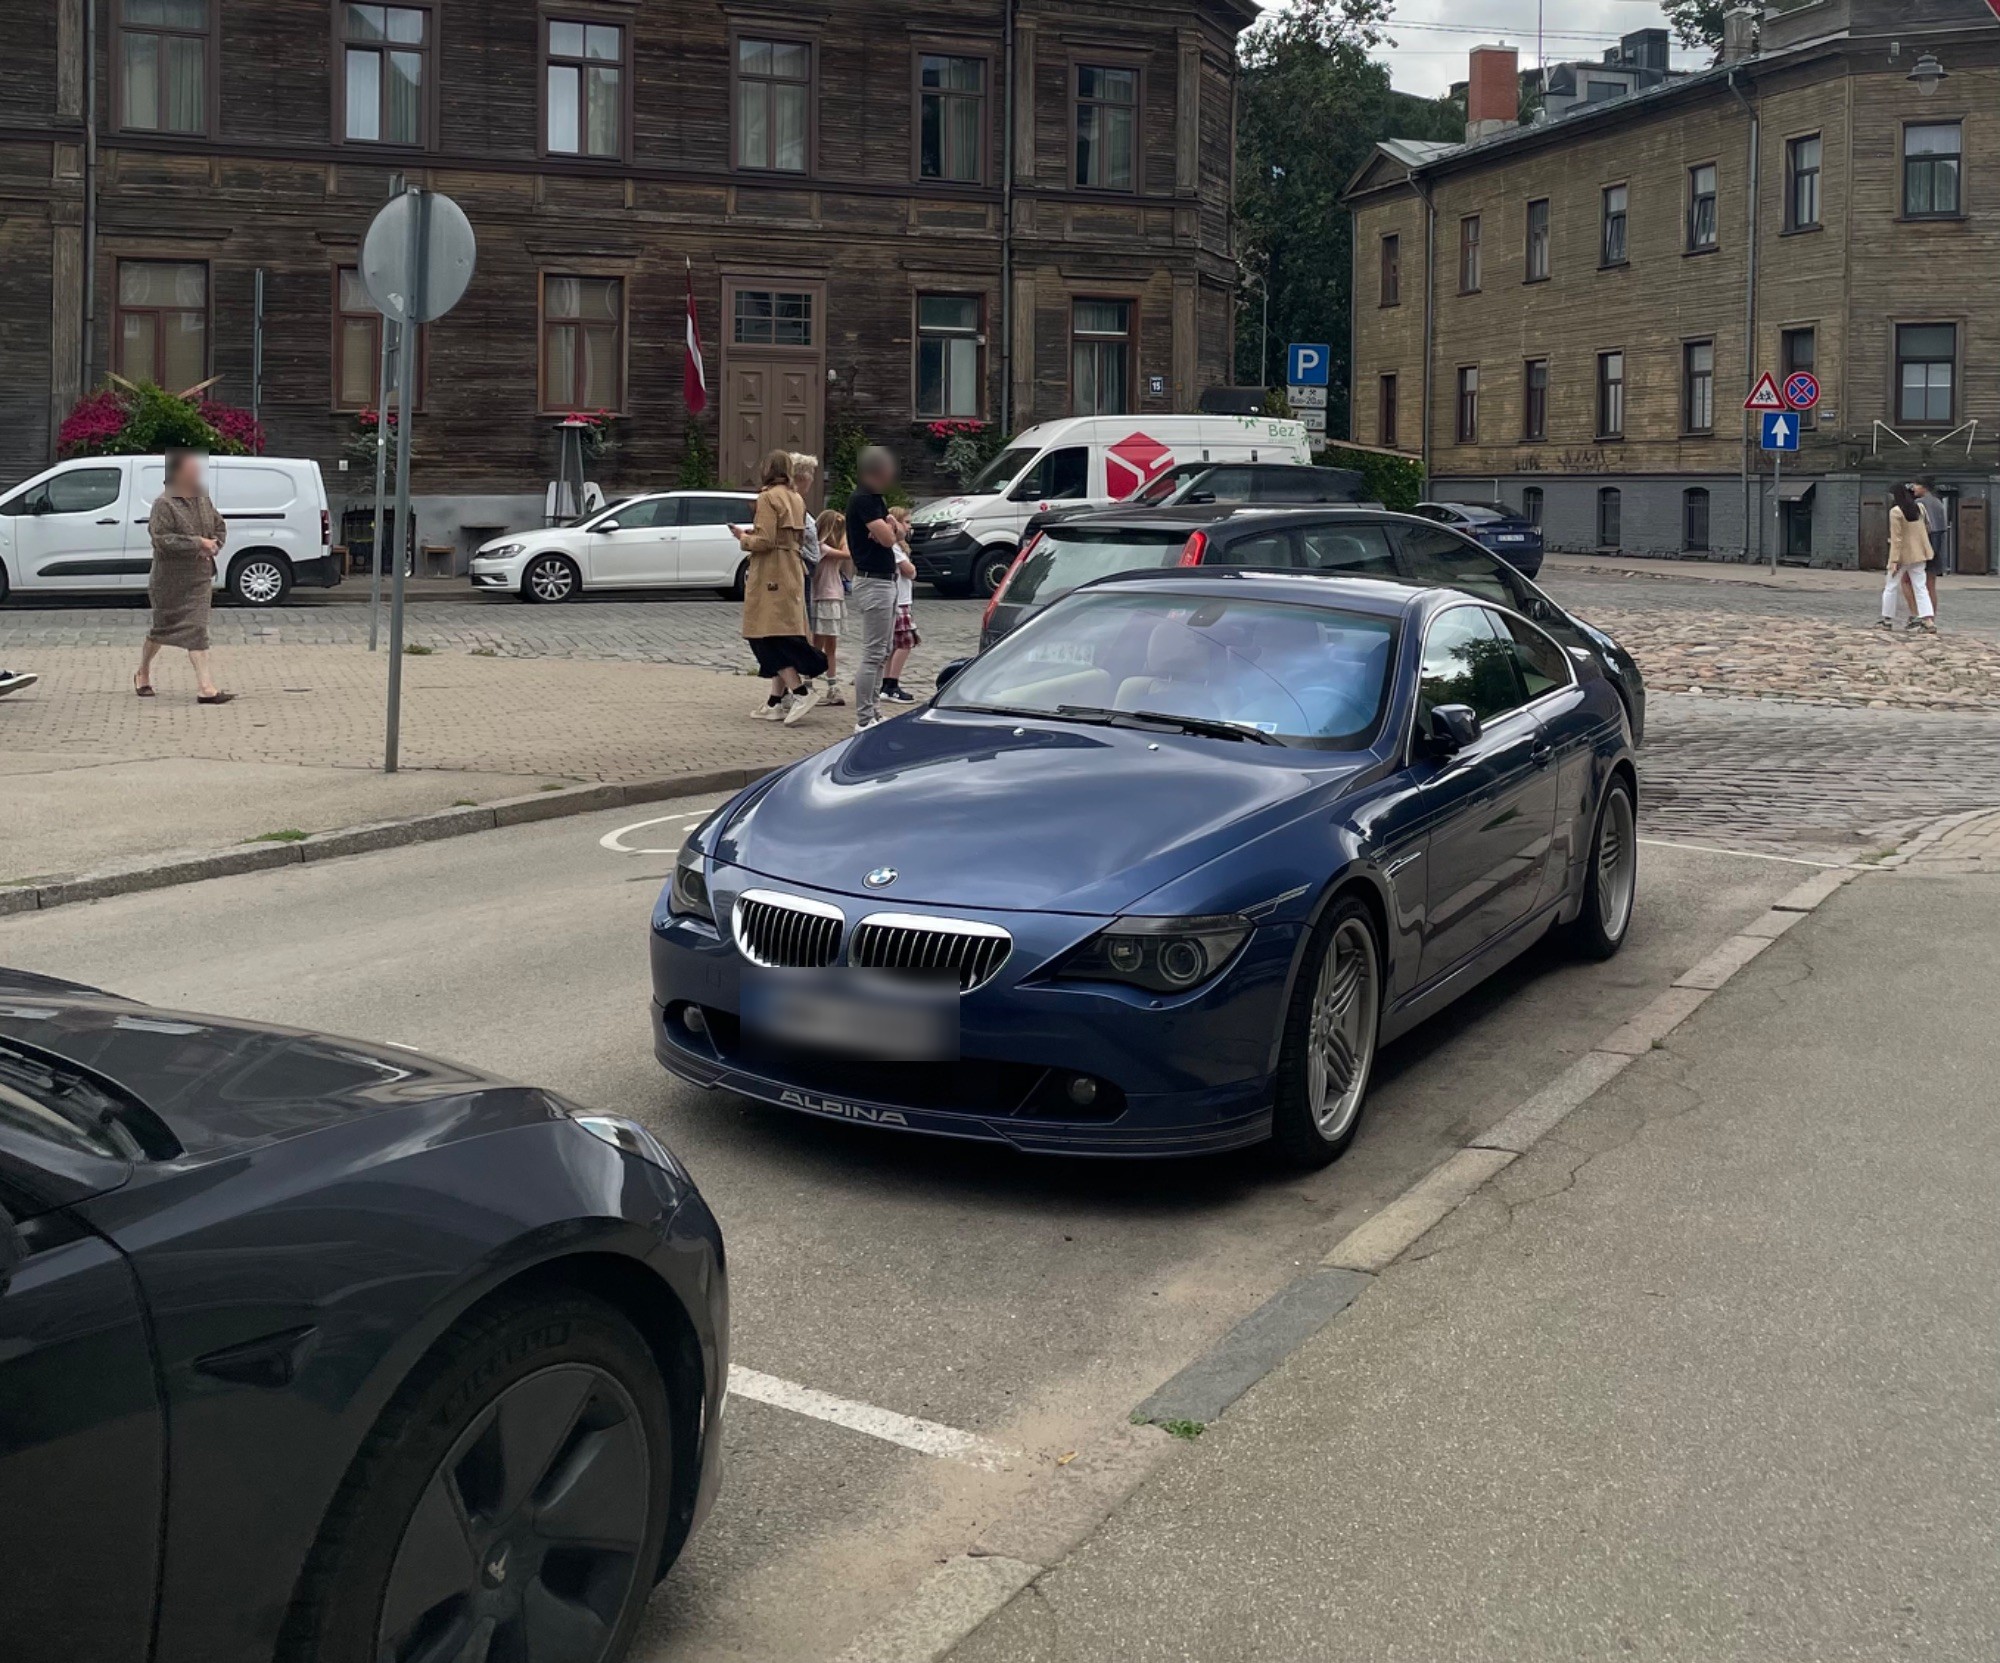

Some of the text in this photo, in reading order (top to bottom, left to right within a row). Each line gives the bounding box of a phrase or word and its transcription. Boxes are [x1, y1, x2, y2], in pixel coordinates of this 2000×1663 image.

[1297, 349, 1319, 379] P
[1151, 381, 1161, 392] 15
[1268, 424, 1295, 437] Bez
[779, 1089, 909, 1126] ALPINA
